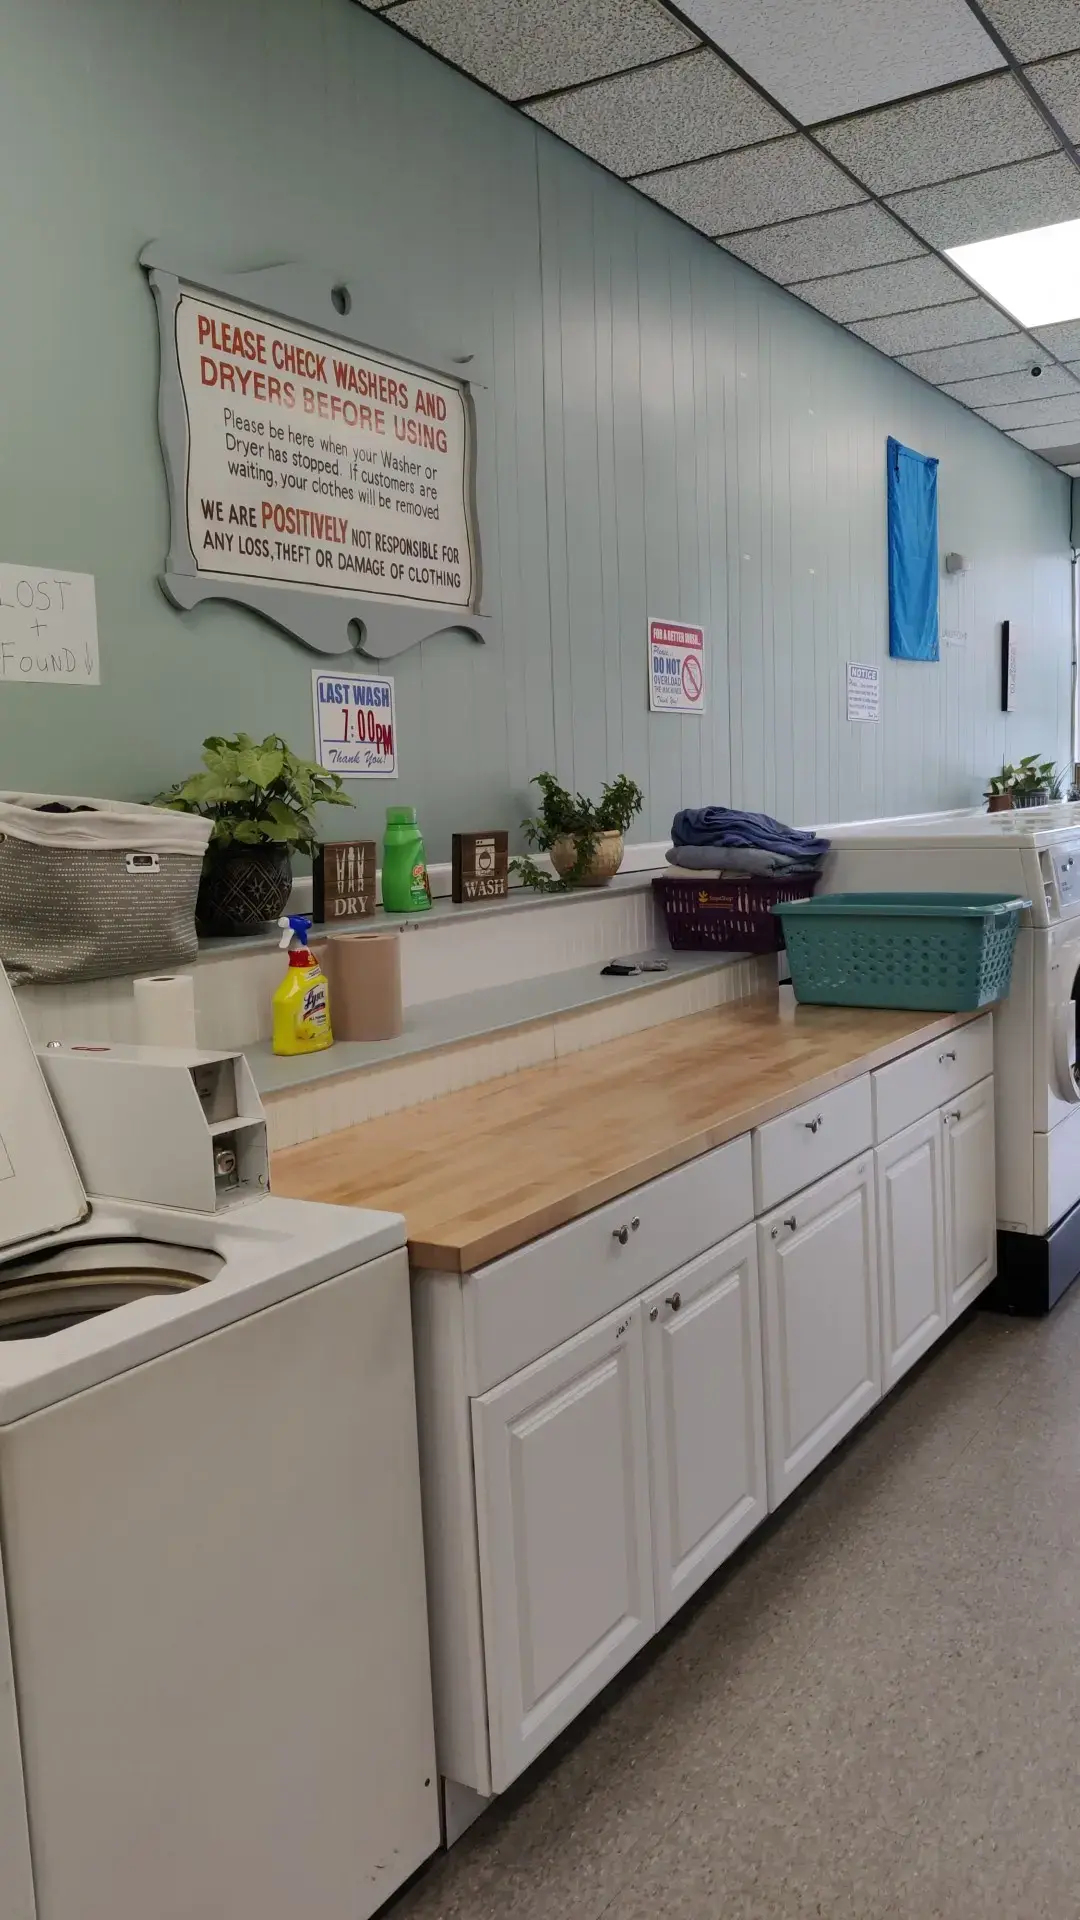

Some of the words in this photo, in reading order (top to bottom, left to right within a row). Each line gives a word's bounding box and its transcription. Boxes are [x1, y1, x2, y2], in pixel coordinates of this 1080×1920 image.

[198, 314, 266, 365] PLEASE
[272, 340, 327, 383] CHECK
[333, 358, 408, 409] WASHERS
[415, 389, 447, 421] AND
[200, 356, 295, 408] DRYERS
[303, 387, 385, 436] BEFORE
[394, 414, 448, 453] USING
[224, 408, 264, 437] Please
[269, 420, 284, 441] be
[289, 424, 315, 448] here
[320, 433, 348, 457] when
[353, 445, 378, 464] your
[381, 450, 421, 477] Washer
[425, 465, 437, 480] or
[226, 433, 264, 461] Dryer
[269, 446, 288, 464] has
[293, 452, 342, 479] stopped.
[350, 463, 358, 480] If
[362, 469, 414, 495] customers
[420, 483, 437, 500] are
[228, 461, 277, 487] waiting,
[281, 472, 308, 491] your
[312, 473, 353, 500] clothes
[359, 489, 375, 505] will
[379, 495, 390, 509] be
[396, 498, 439, 520] removed
[201, 499, 224, 521] WE
[229, 503, 257, 528] ARE
[262, 501, 348, 545] POSITIVELY
[351, 528, 371, 548] NOT
[375, 531, 438, 561] RESPONSIBLE
[443, 546, 459, 564] FOR
[203, 530, 233, 552] ANY
[316, 549, 333, 569] OR
[338, 552, 385, 577] DAMAGE
[390, 563, 404, 579] OF
[408, 567, 461, 588] CLOTHING
[653, 628, 662, 640] FOR
[653, 656, 664, 673] DO
[666, 659, 681, 675] NOT
[851, 667, 877, 680] NOTICE
[653, 675, 681, 687] OVERLOAD
[319, 683, 350, 704] LAST
[353, 685, 390, 707] WASH
[328, 749, 361, 764] Thank
[363, 750, 387, 768] You!
[464, 878, 505, 898] WASH
[334, 895, 369, 916] DRY
